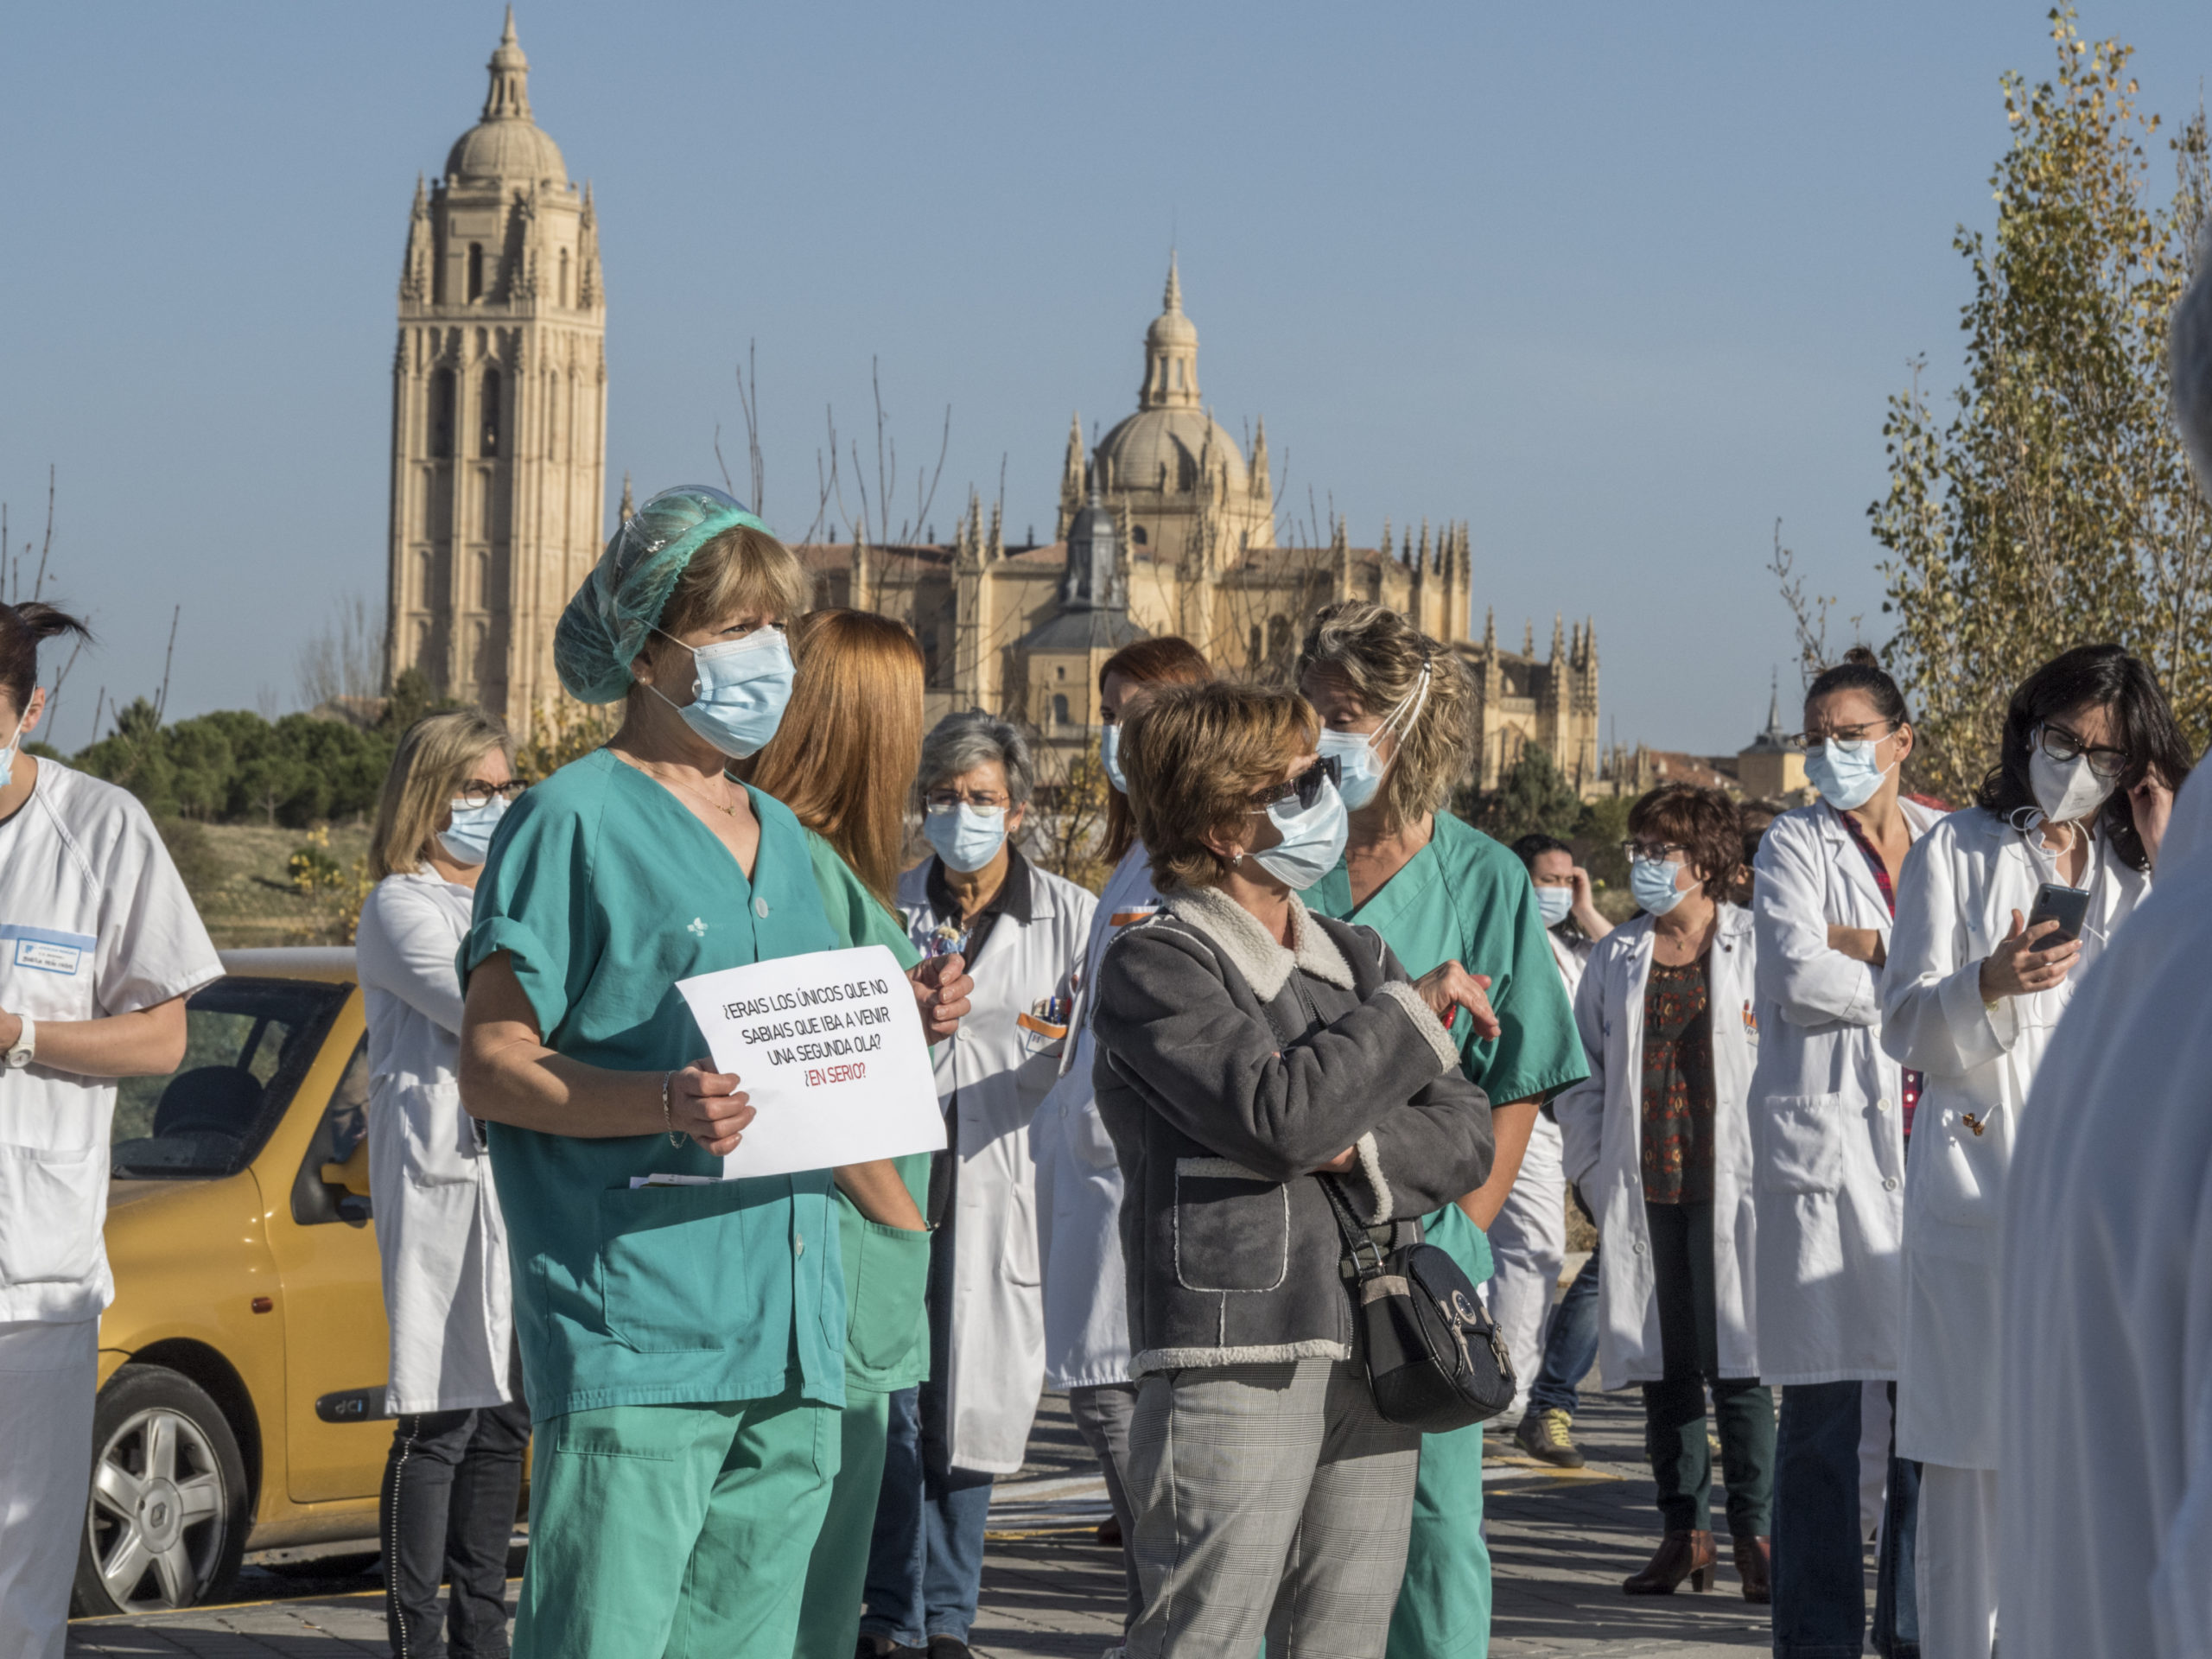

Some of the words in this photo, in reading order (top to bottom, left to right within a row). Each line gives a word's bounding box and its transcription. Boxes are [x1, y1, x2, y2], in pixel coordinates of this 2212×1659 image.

[722, 998, 770, 1020] ¿ERAIS
[769, 993, 797, 1011] LOS
[796, 987, 843, 1007] ÚNICOS
[843, 982, 870, 999] QUE
[868, 979, 888, 995] NO
[741, 1021, 794, 1044] SABIAIS
[794, 1018, 822, 1035] QUE
[820, 1014, 844, 1031] IBA
[845, 1012, 856, 1028] A
[854, 1007, 891, 1026] VENIR
[766, 1047, 797, 1065] UNA
[796, 1039, 854, 1061] SEGUNDA
[854, 1033, 881, 1052] OLA?
[804, 1068, 827, 1087] ¿EN
[827, 1062, 867, 1083] SERIO?
